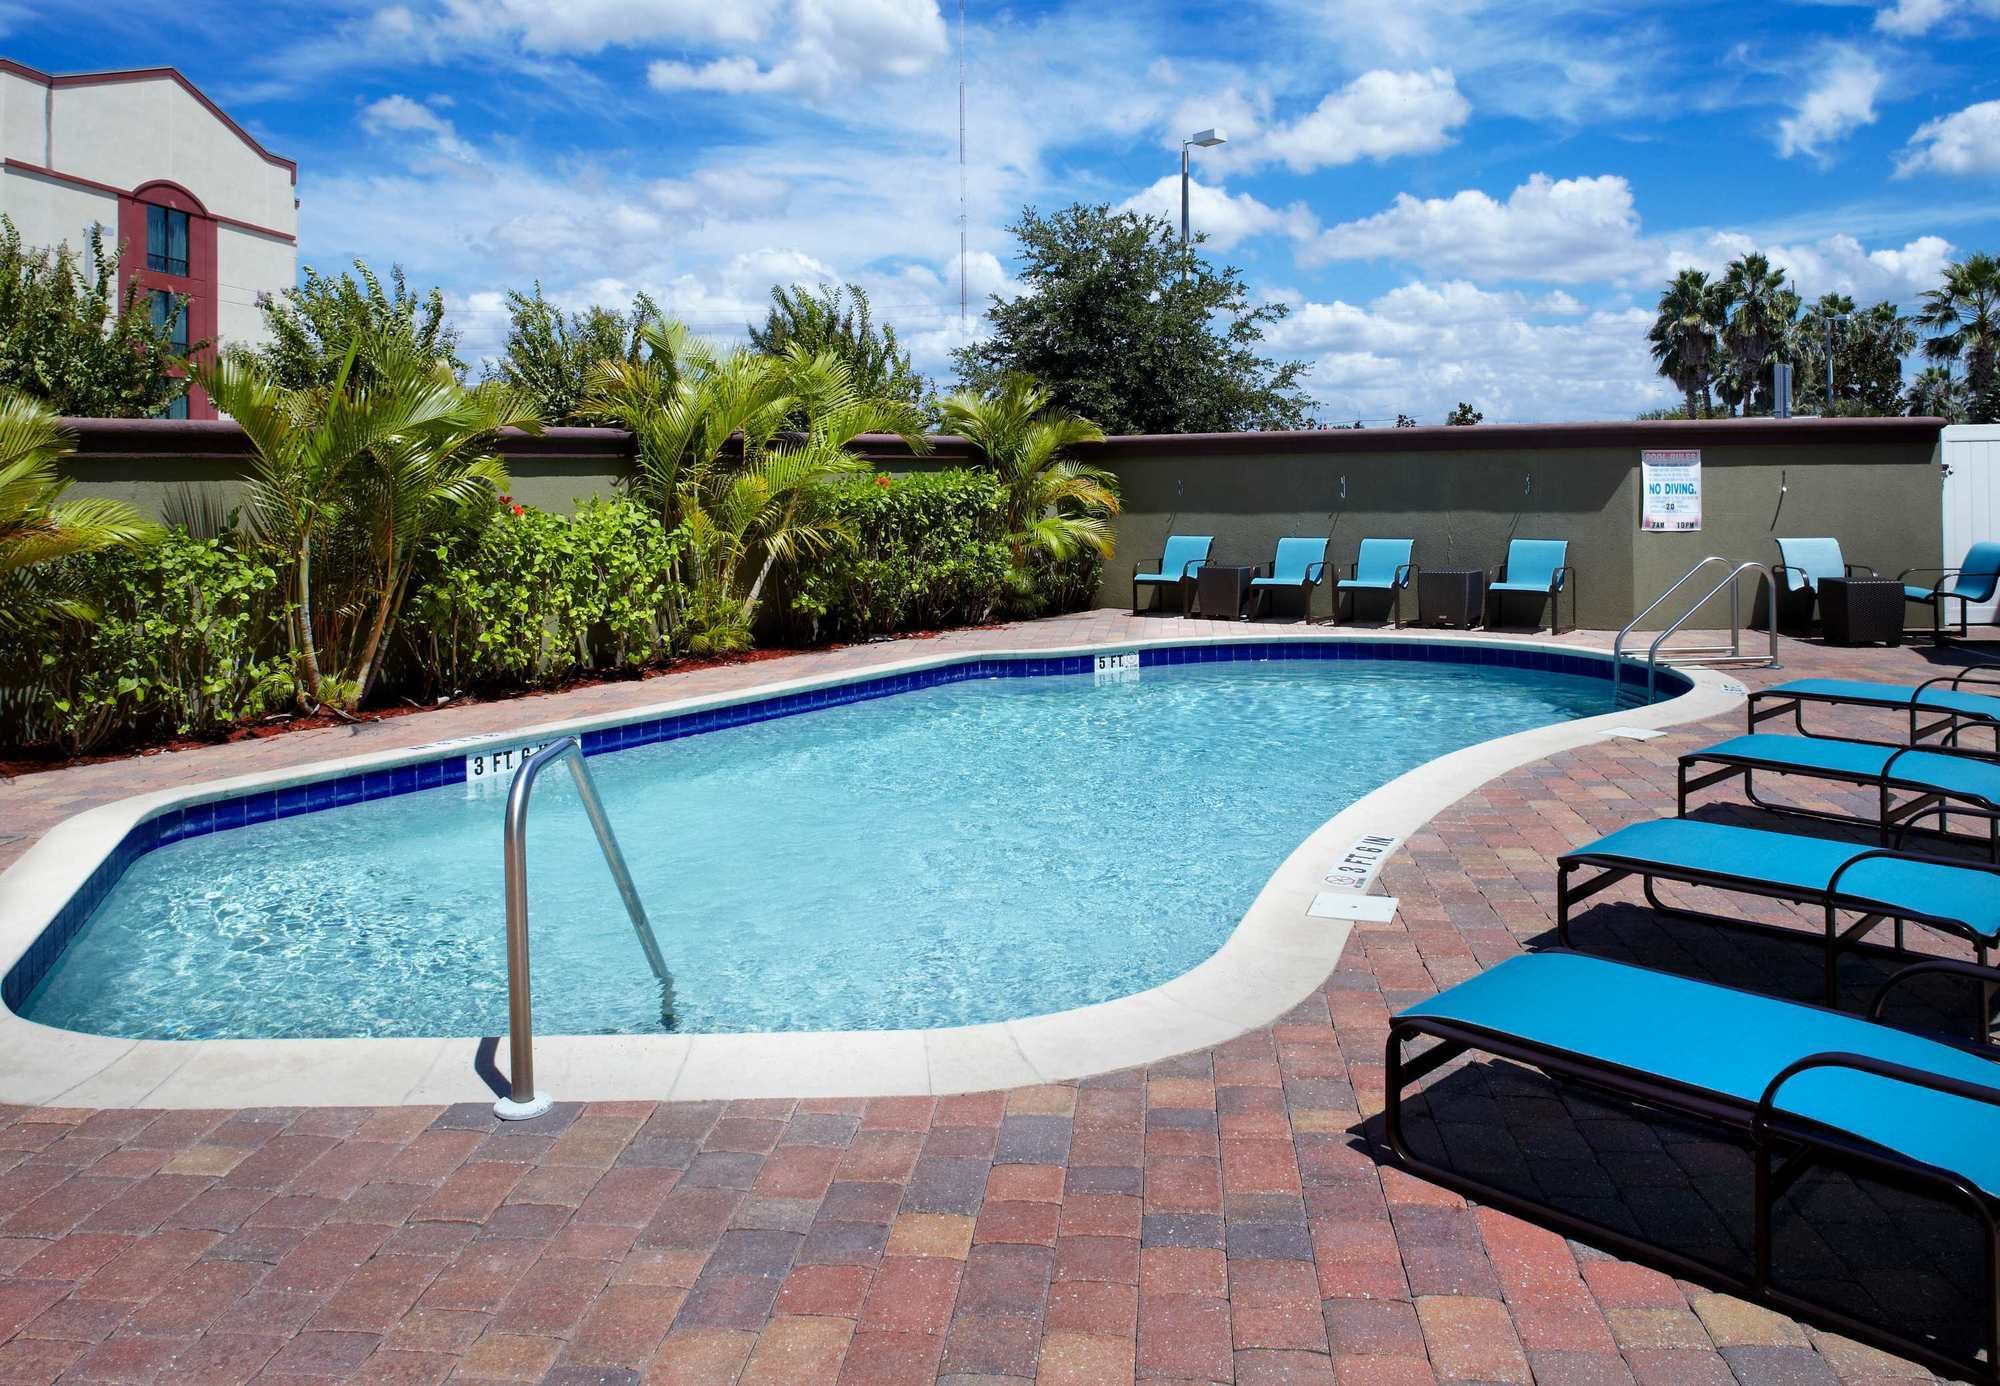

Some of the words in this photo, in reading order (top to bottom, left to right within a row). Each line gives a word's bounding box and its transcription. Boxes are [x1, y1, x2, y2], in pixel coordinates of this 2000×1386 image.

[1649, 483, 1661, 494] NO
[1099, 656, 1105, 669] 5
[474, 756, 484, 776] 3
[1338, 866, 1367, 874] 3
